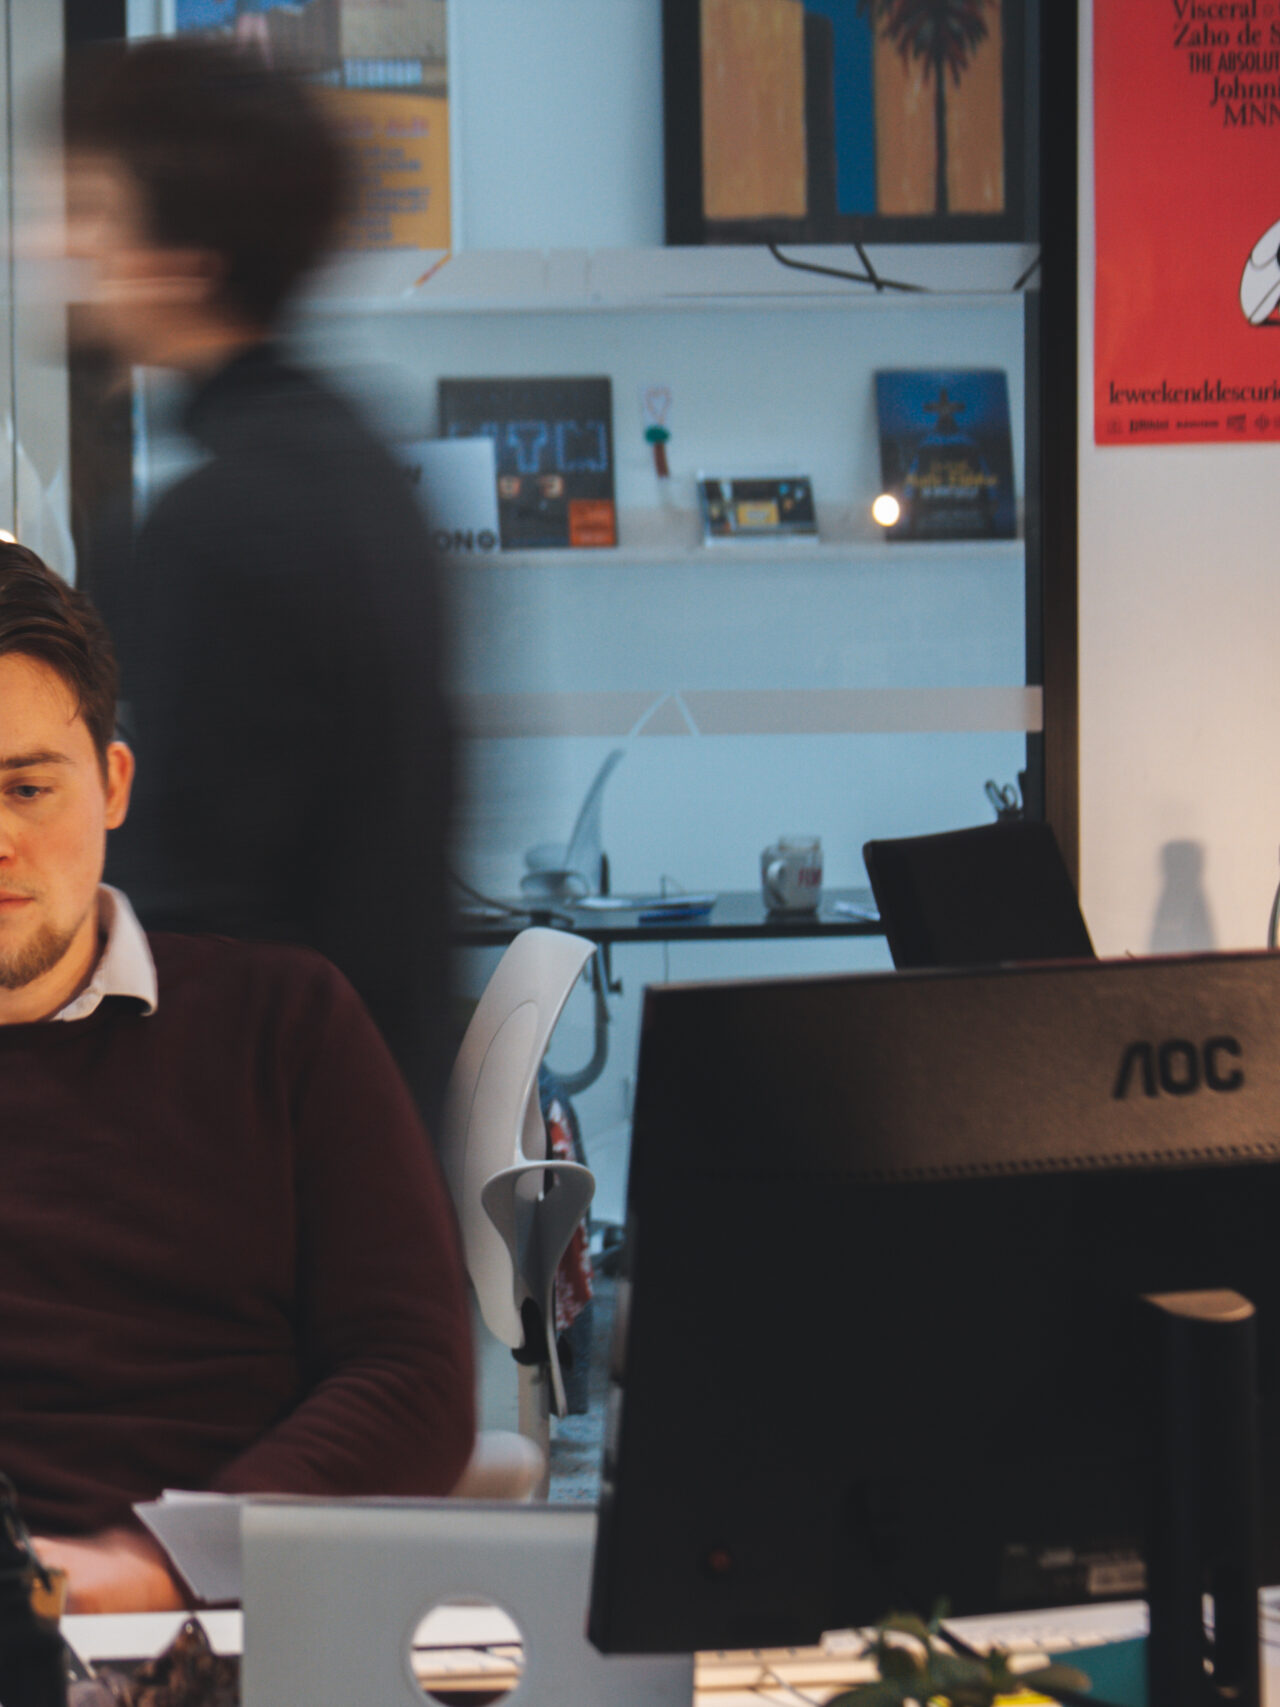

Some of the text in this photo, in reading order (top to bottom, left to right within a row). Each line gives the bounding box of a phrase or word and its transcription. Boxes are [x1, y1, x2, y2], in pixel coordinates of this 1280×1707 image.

[1174, 0, 1257, 19] Visceral
[1174, 22, 1230, 47] Zaho
[1237, 22, 1262, 46] de
[1189, 52, 1212, 73] THE
[1210, 75, 1280, 108] Johnn
[1109, 379, 1280, 404] leweekenddescuri
[1111, 1034, 1246, 1100] AOC
